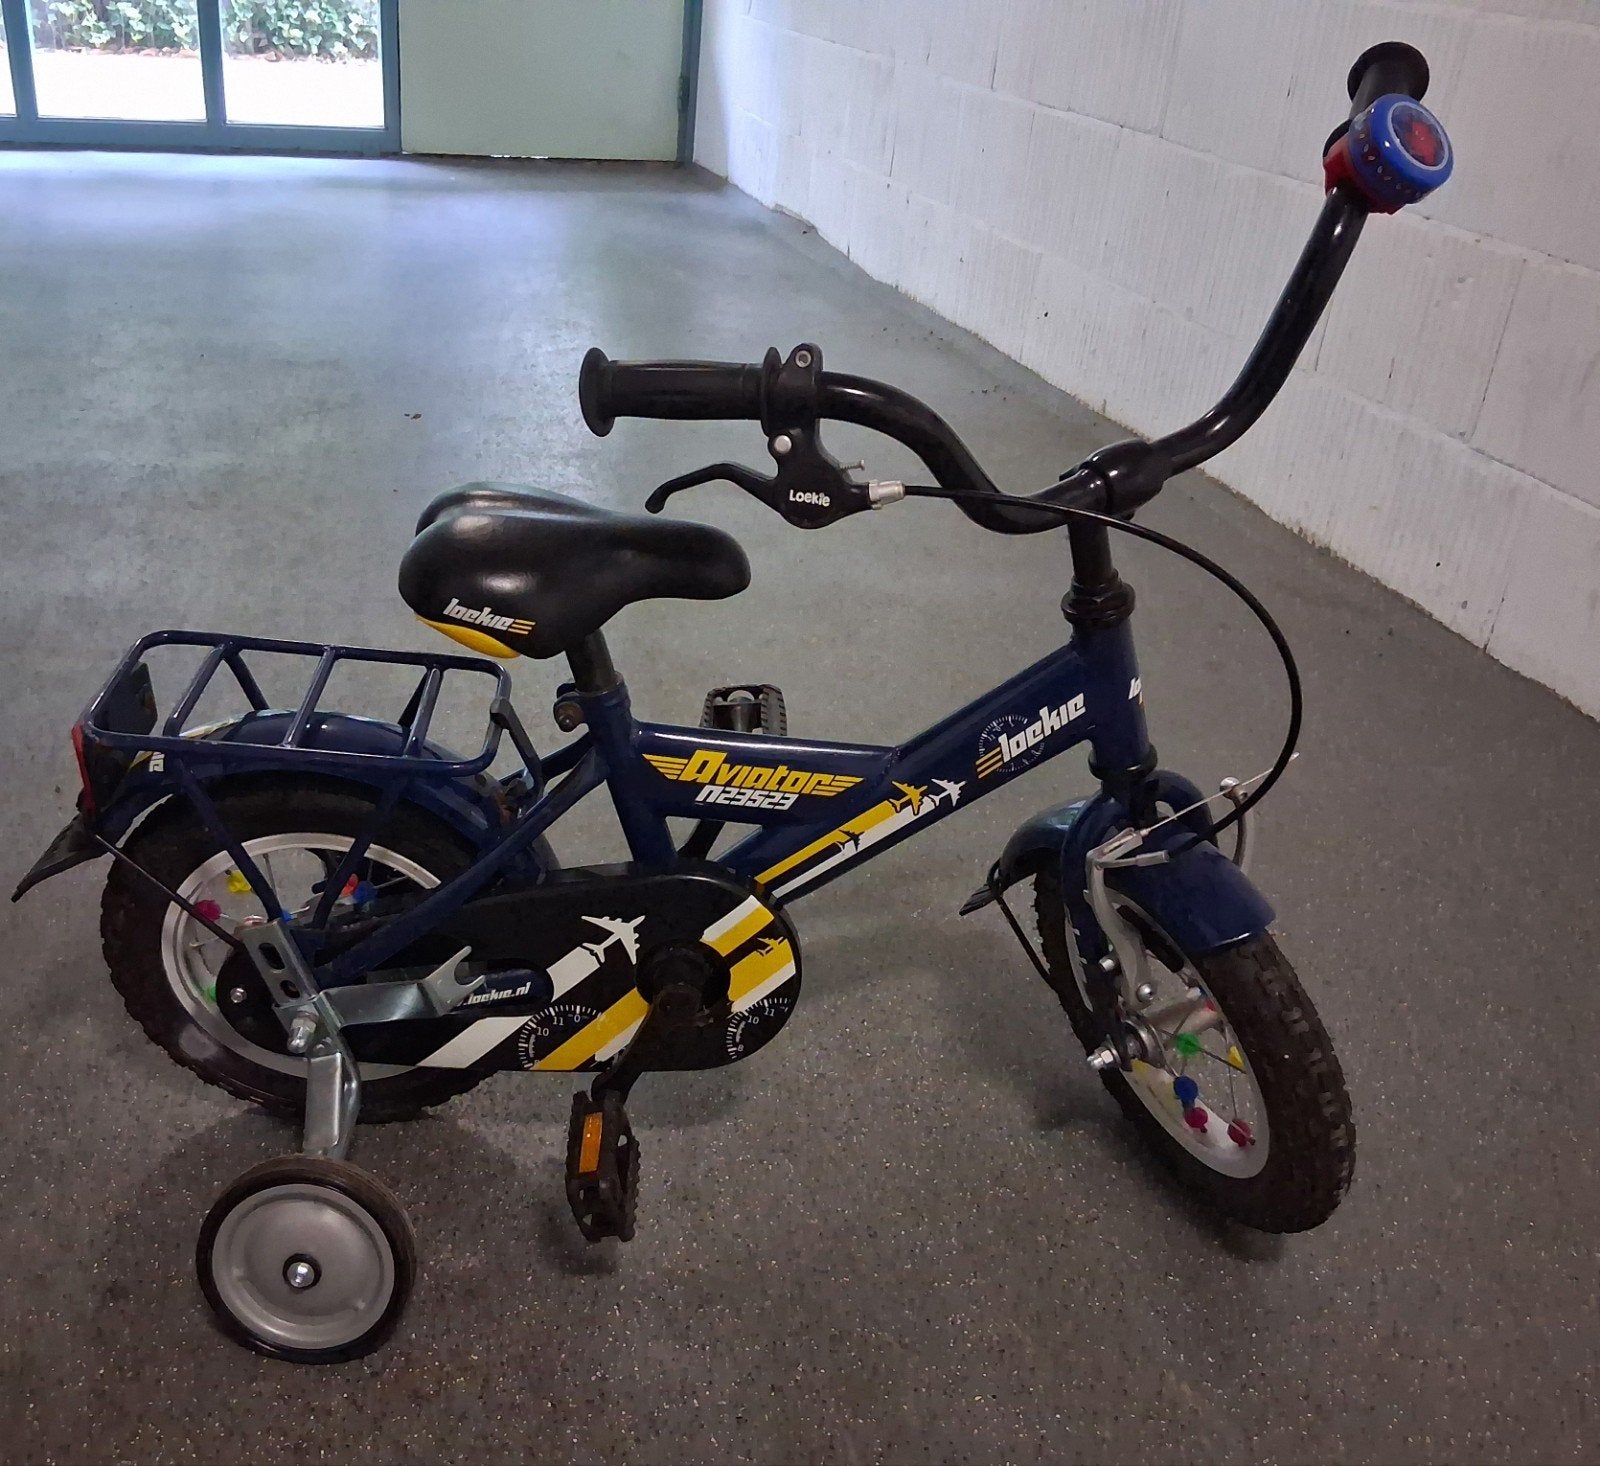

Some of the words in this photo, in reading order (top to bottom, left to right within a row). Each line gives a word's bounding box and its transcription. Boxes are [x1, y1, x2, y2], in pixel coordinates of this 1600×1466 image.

[788, 489, 830, 507] Loekie
[442, 597, 515, 631] loekie
[998, 692, 1087, 763] loekie
[678, 749, 834, 794] Aviator
[536, 1026, 549, 1037] 10
